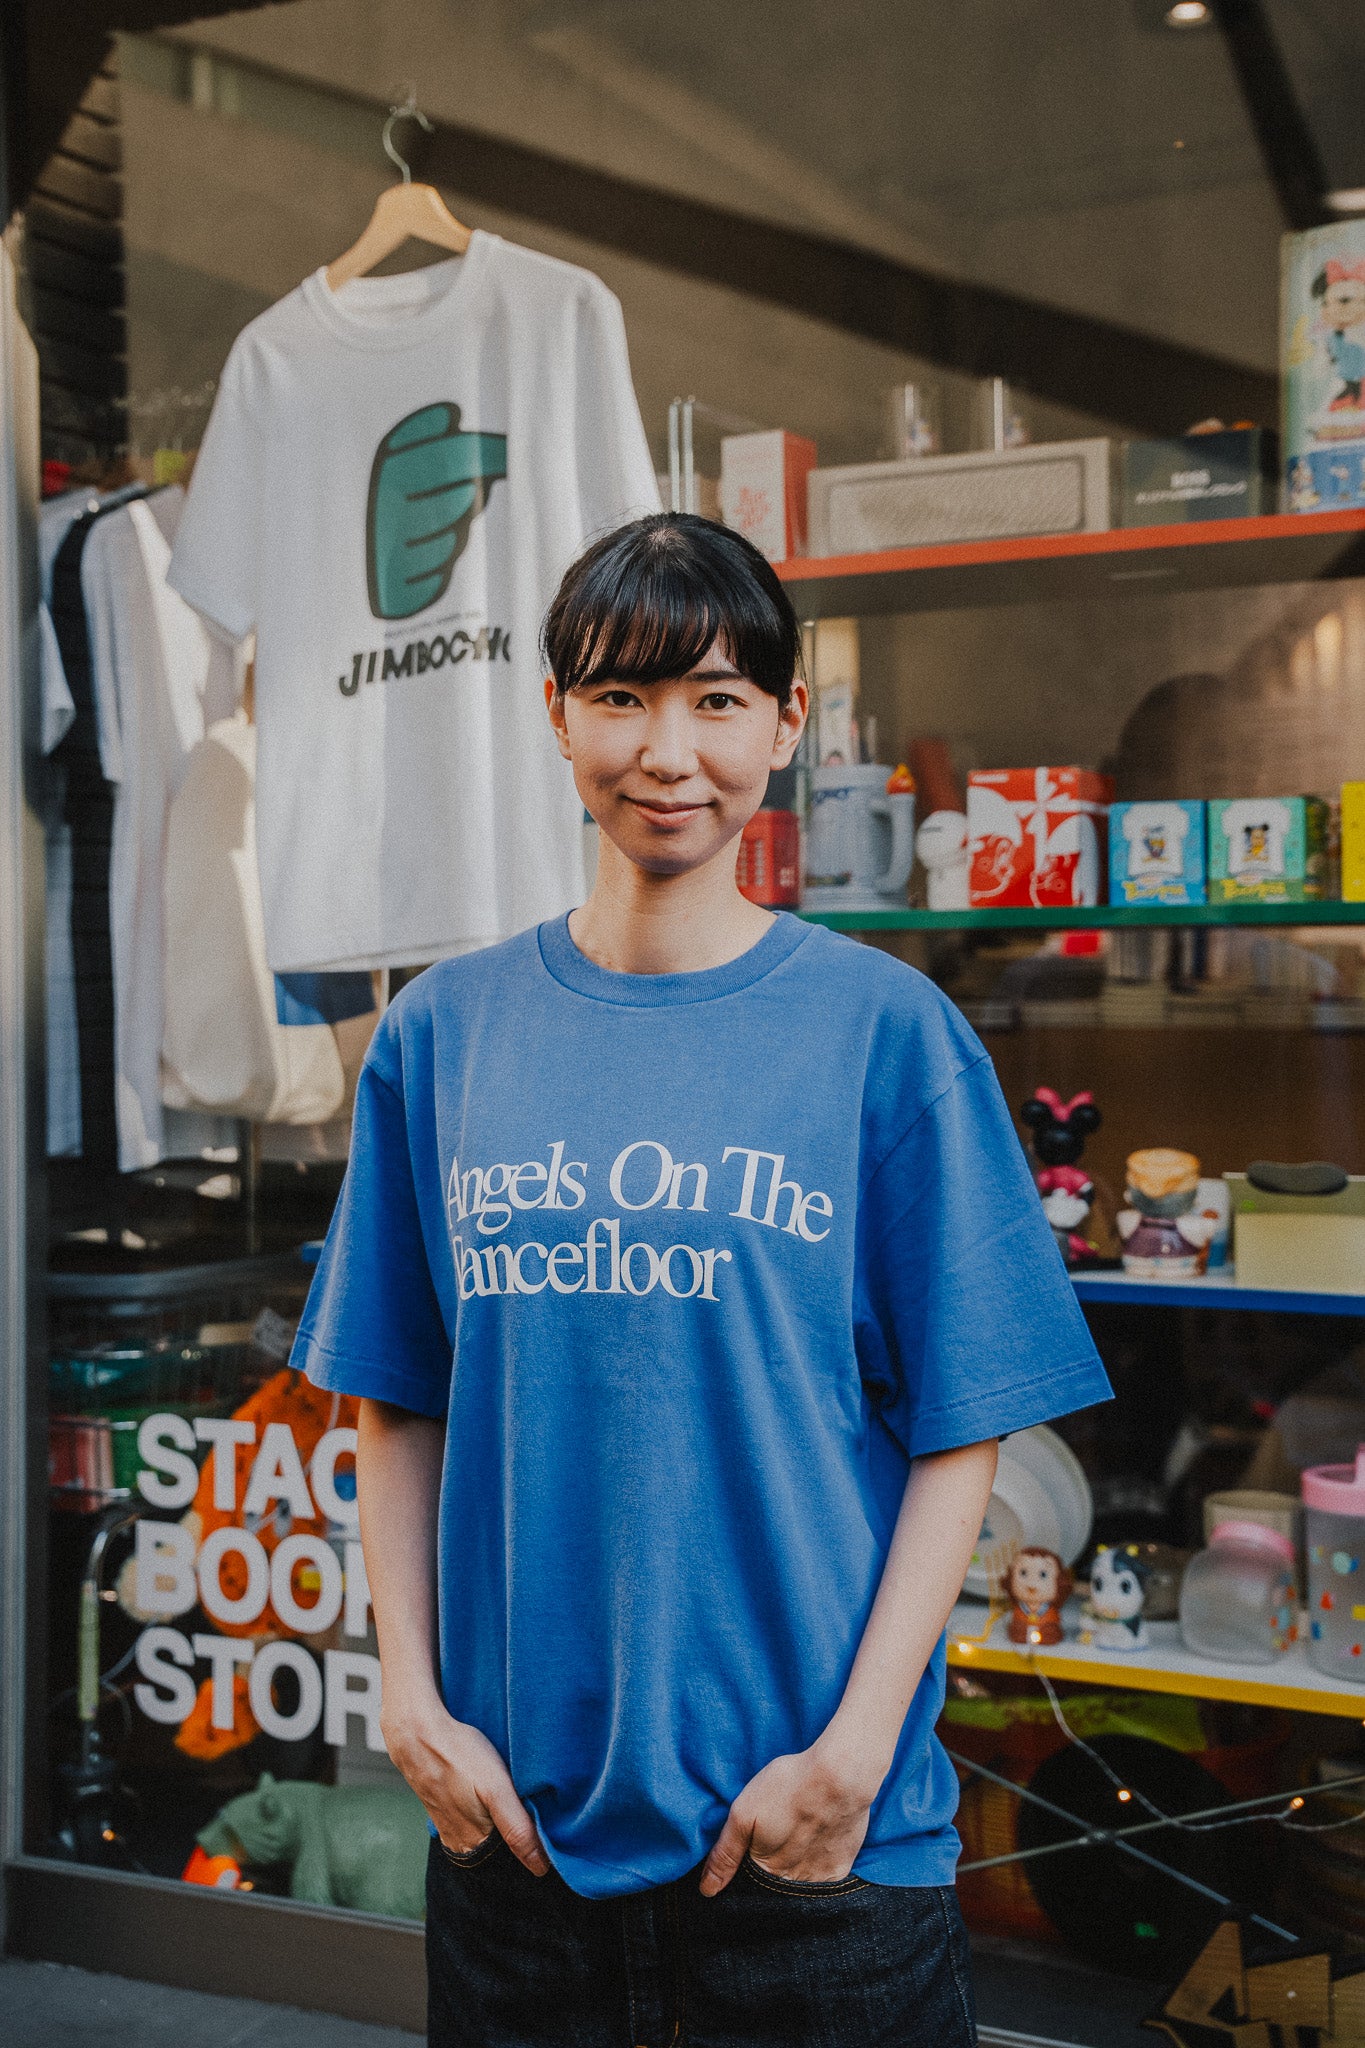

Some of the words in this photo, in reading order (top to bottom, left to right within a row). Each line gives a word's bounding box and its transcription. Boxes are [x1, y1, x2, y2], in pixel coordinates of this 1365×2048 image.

[446, 1139, 588, 1236] Angels
[609, 1140, 710, 1212] On
[722, 1146, 833, 1243] The
[133, 1626, 389, 1752] STOR
